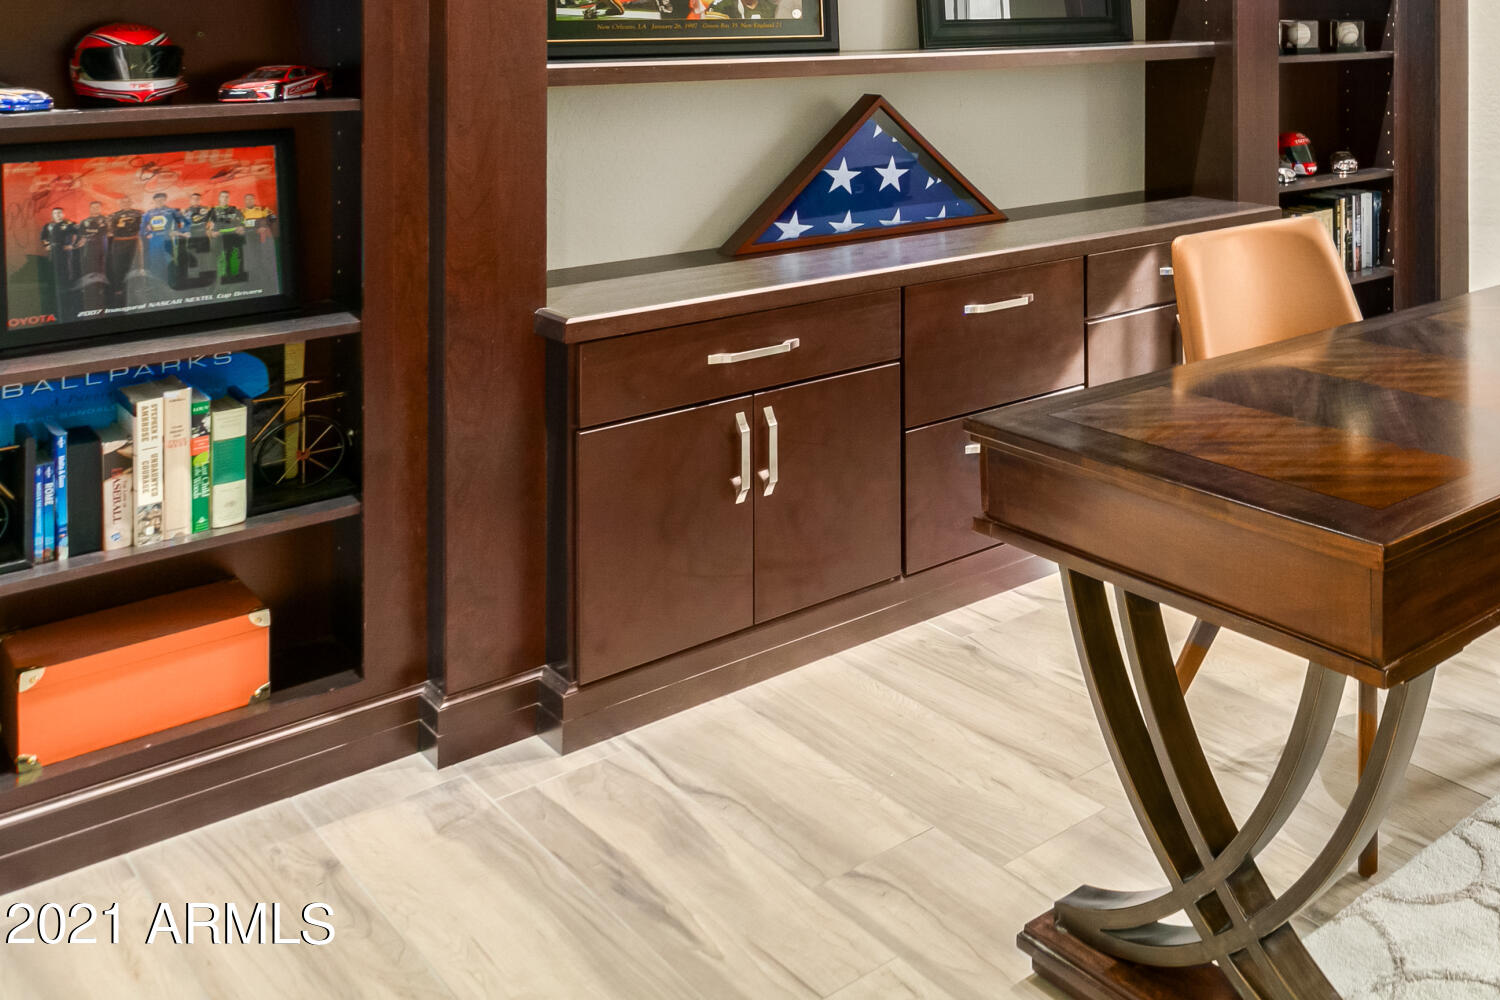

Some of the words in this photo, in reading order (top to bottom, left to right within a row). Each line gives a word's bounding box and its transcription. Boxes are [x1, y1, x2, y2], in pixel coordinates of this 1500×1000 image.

[77, 308, 104, 318] 2007
[104, 302, 149, 314] Inaugural
[148, 298, 183, 308] NASCAR
[183, 294, 213, 303] NEXTEL
[216, 292, 232, 300] Cup
[233, 288, 263, 297] Drivers
[2, 351, 234, 400] BALLPARKS
[141, 405, 149, 443] AMBROSE
[142, 460, 150, 494] COURAGE
[151, 453, 159, 497] UNDAUNTED
